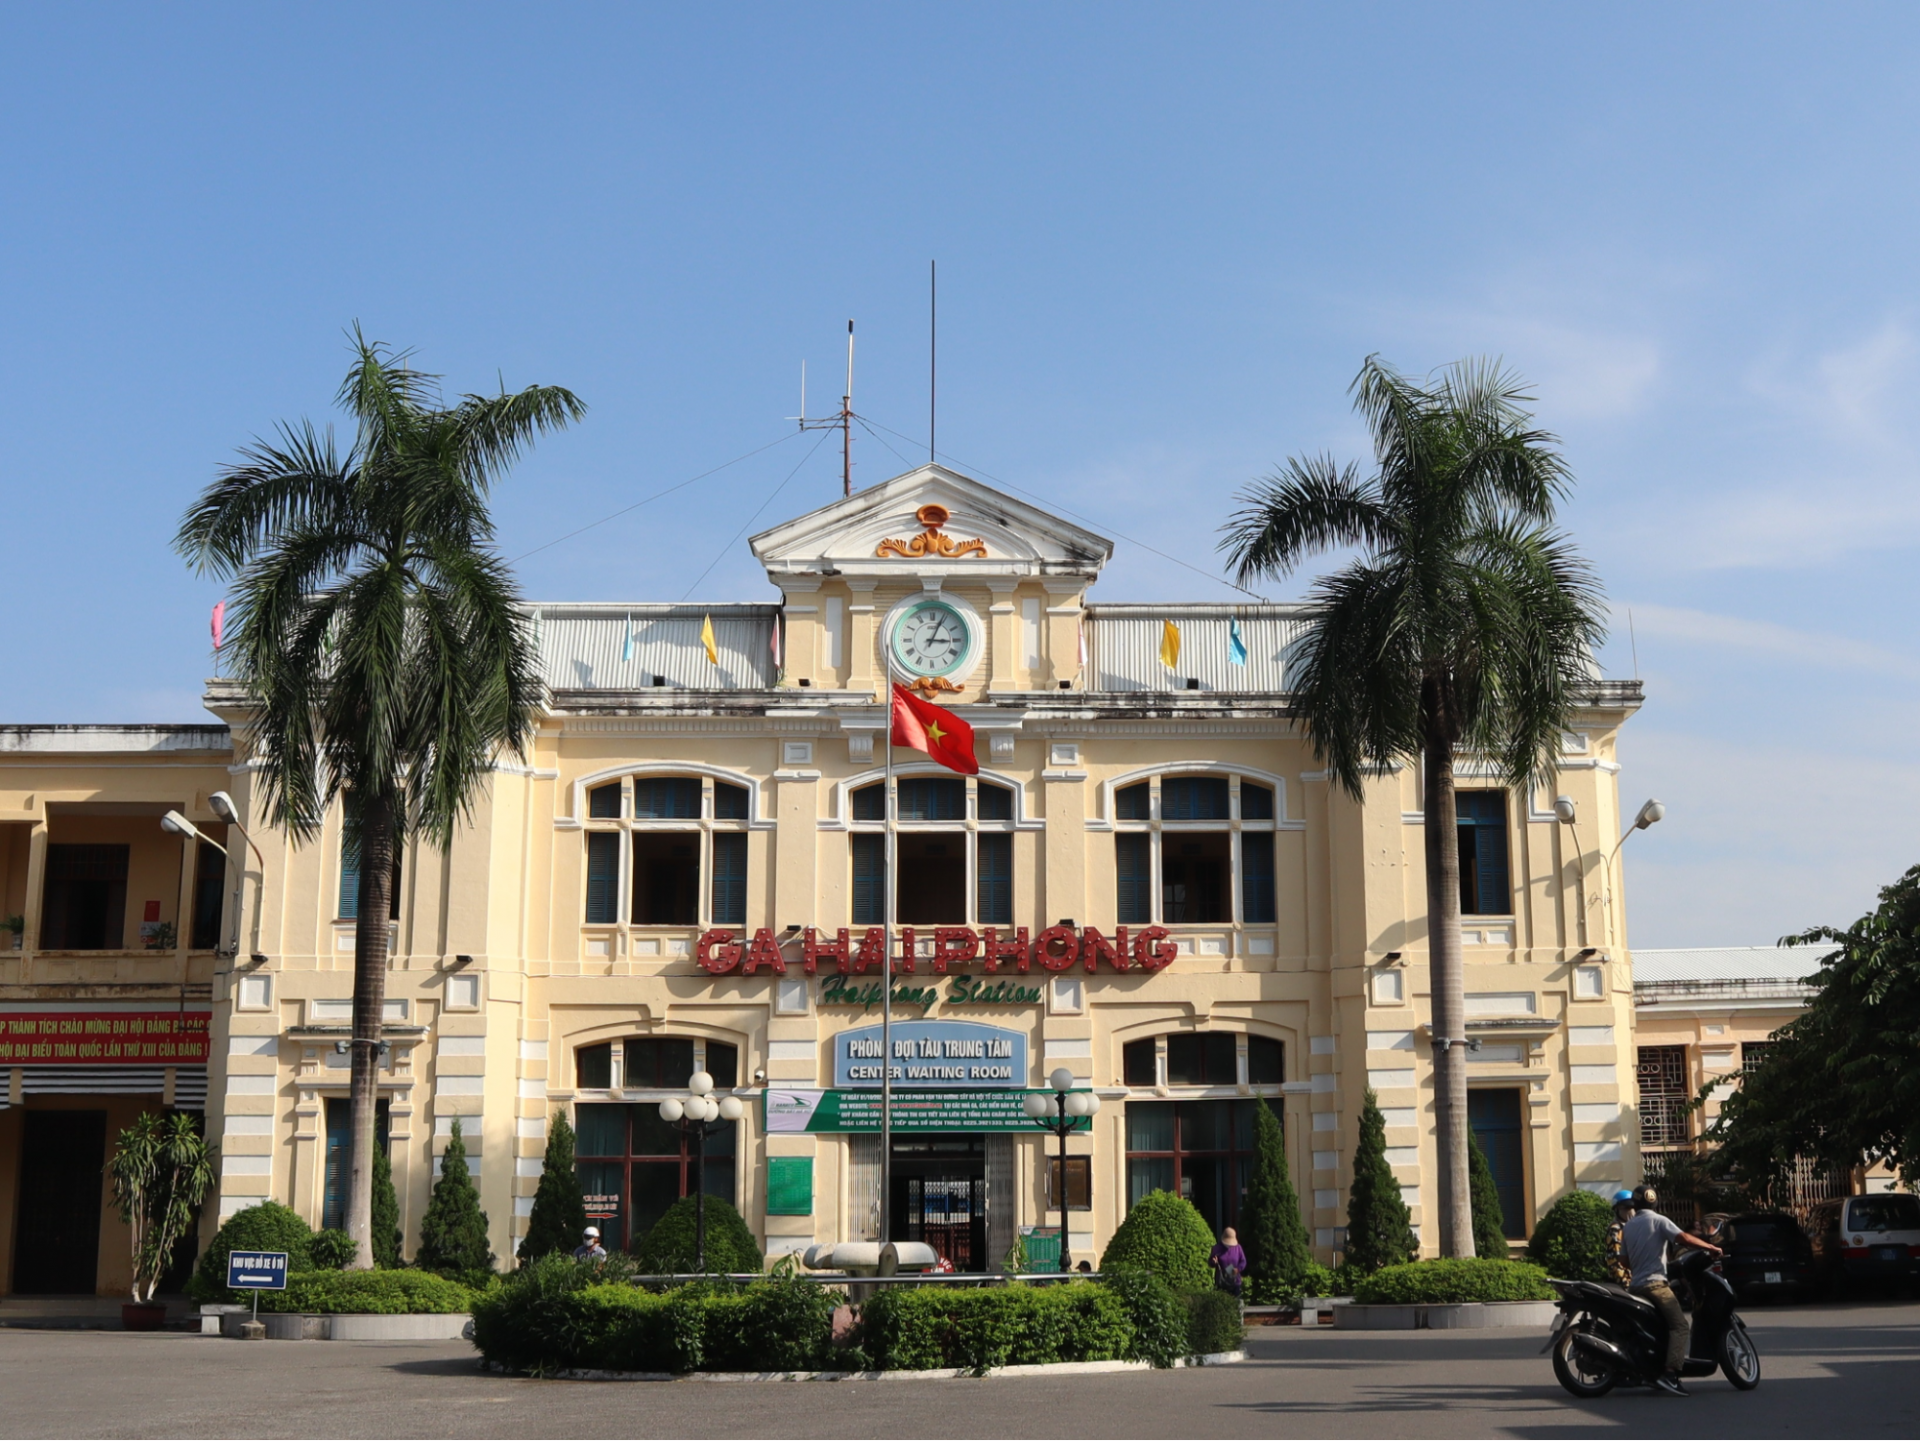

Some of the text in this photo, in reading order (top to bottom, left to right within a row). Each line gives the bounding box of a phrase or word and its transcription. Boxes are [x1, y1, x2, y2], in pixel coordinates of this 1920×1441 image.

[696, 926, 1178, 974] GA HAI PHONG
[950, 974, 1042, 1004] Station
[8, 1017, 36, 1034] THÀNH
[39, 1018, 58, 1034] TÍCH
[60, 1017, 83, 1034] CHÀO
[85, 1017, 111, 1034] MỪNG
[113, 1020, 128, 1037] ĐẠI
[130, 1017, 144, 1036] HỘI
[147, 1015, 170, 1034] ĐẢNG
[15, 1044, 30, 1060] ĐẠI
[32, 1038, 52, 1057] BIỂU
[54, 1040, 76, 1057] TOÀN
[79, 1038, 102, 1058] QUỐC
[124, 1040, 141, 1057] THỨ
[142, 1043, 156, 1057] XIII
[159, 1038, 176, 1056] CỦA
[178, 1038, 202, 1056] ĐẢNG
[850, 1036, 1012, 1061] PHÒN ĐỢI TÀU TRUNG TÂM
[908, 1066, 964, 1078] WAITING
[971, 1066, 1012, 1078] ROOM
[263, 1258, 270, 1269] XE
